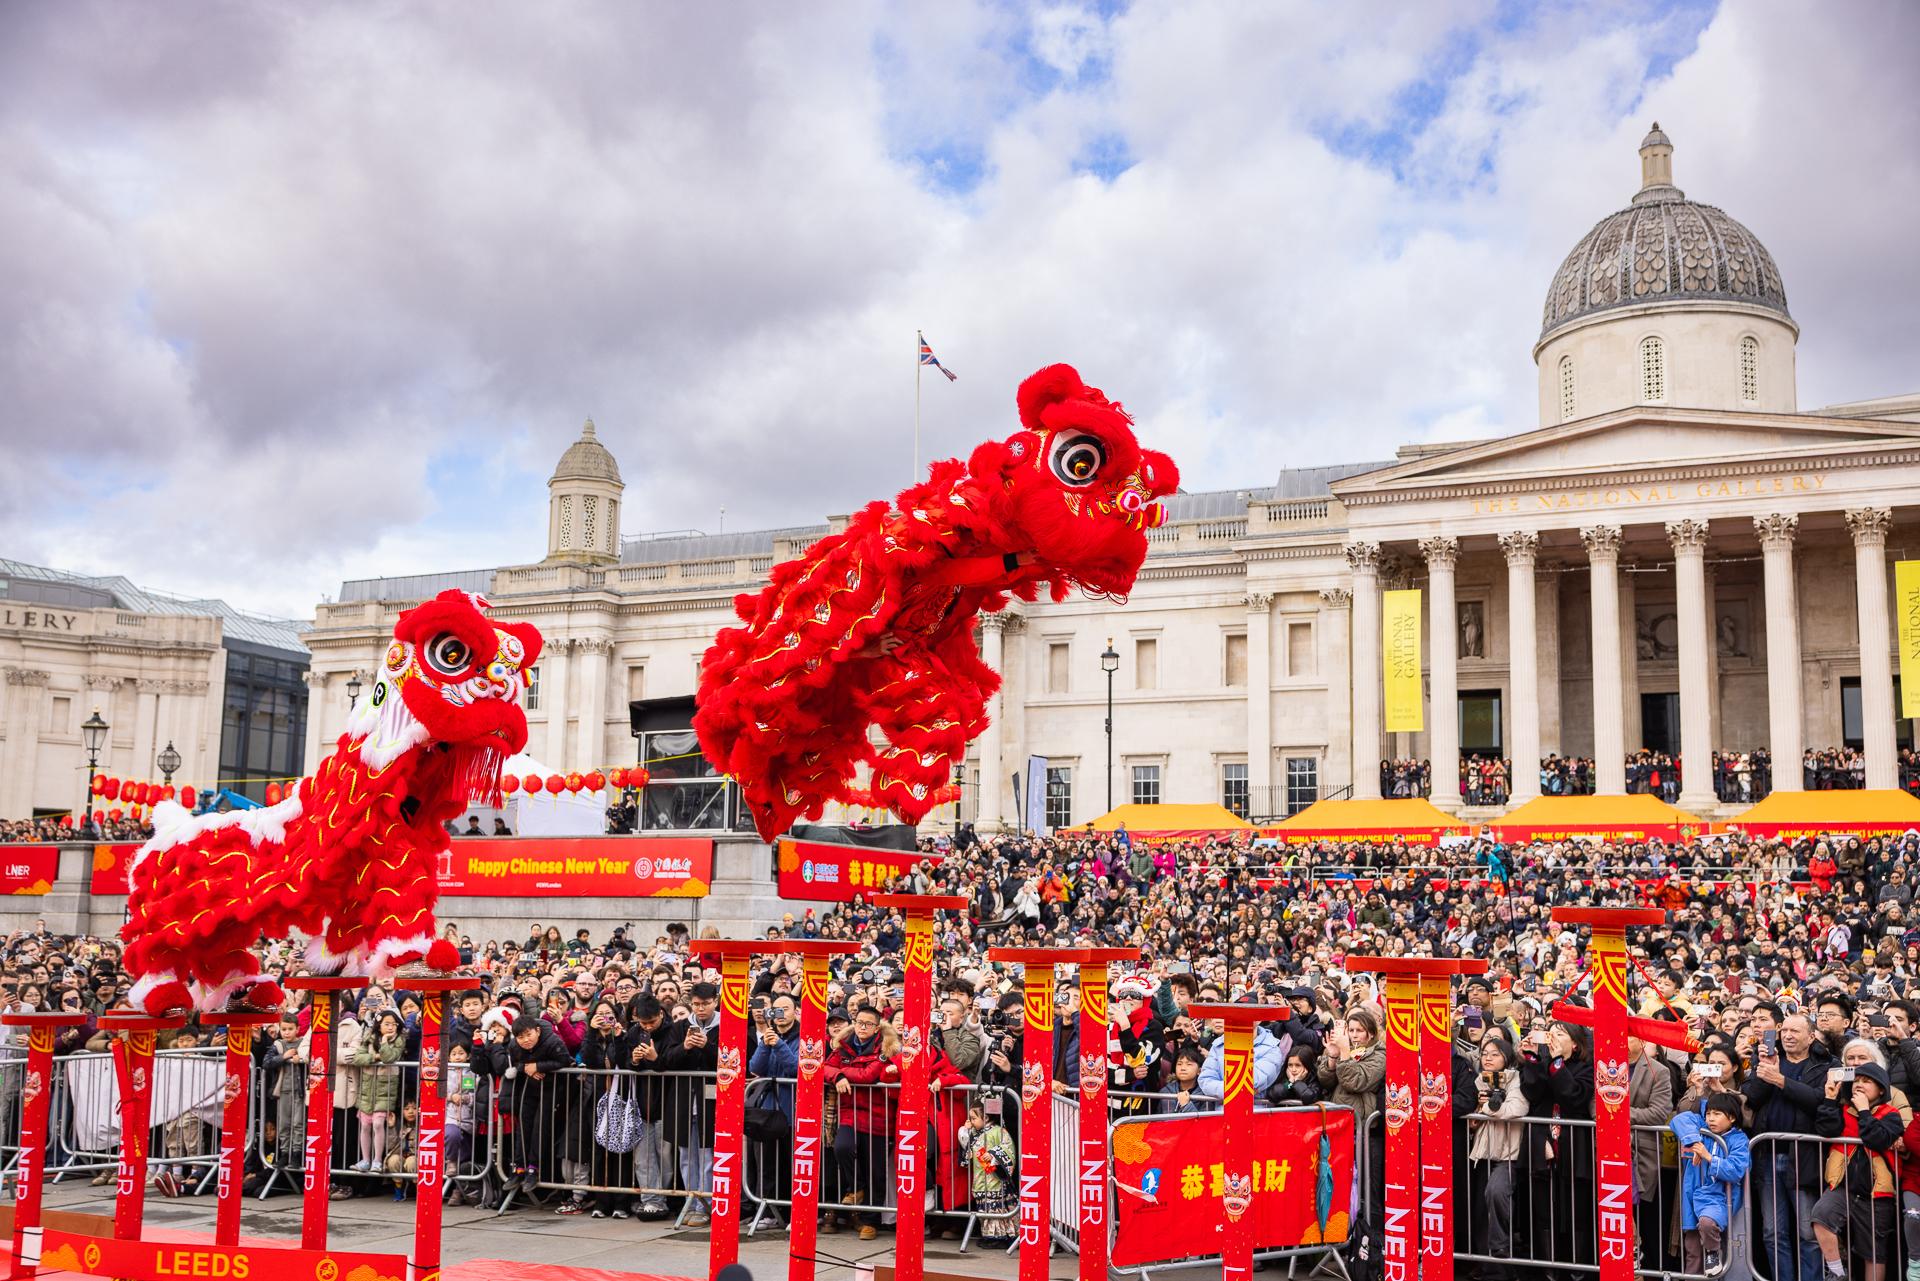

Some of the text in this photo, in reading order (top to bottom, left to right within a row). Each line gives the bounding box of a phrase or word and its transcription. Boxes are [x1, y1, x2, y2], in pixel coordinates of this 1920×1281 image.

[1471, 474, 1828, 514] THE NATIONAL GALLERY
[5, 610, 76, 630] LERY
[1393, 616, 1402, 679] NATIONAL
[1404, 614, 1415, 678] GALLERY
[1340, 835, 1382, 843] INSURANCE
[1531, 832, 1553, 840] BANK
[1777, 830, 1801, 838] BANK
[1804, 830, 1816, 838] OF
[5, 864, 30, 876] LNER
[468, 858, 630, 877] Happy Chinese New Year
[418, 1111, 441, 1186] LNER
[711, 1132, 736, 1217] LNER
[793, 1118, 818, 1197] LNER
[898, 1110, 920, 1195] LNER
[1018, 1154, 1044, 1245] LNER
[1080, 1140, 1105, 1225] LNER
[1421, 1164, 1448, 1257] LNER
[1599, 1159, 1631, 1260] LNER
[1384, 1183, 1411, 1281] LNER
[156, 1250, 249, 1279] LEEDS
